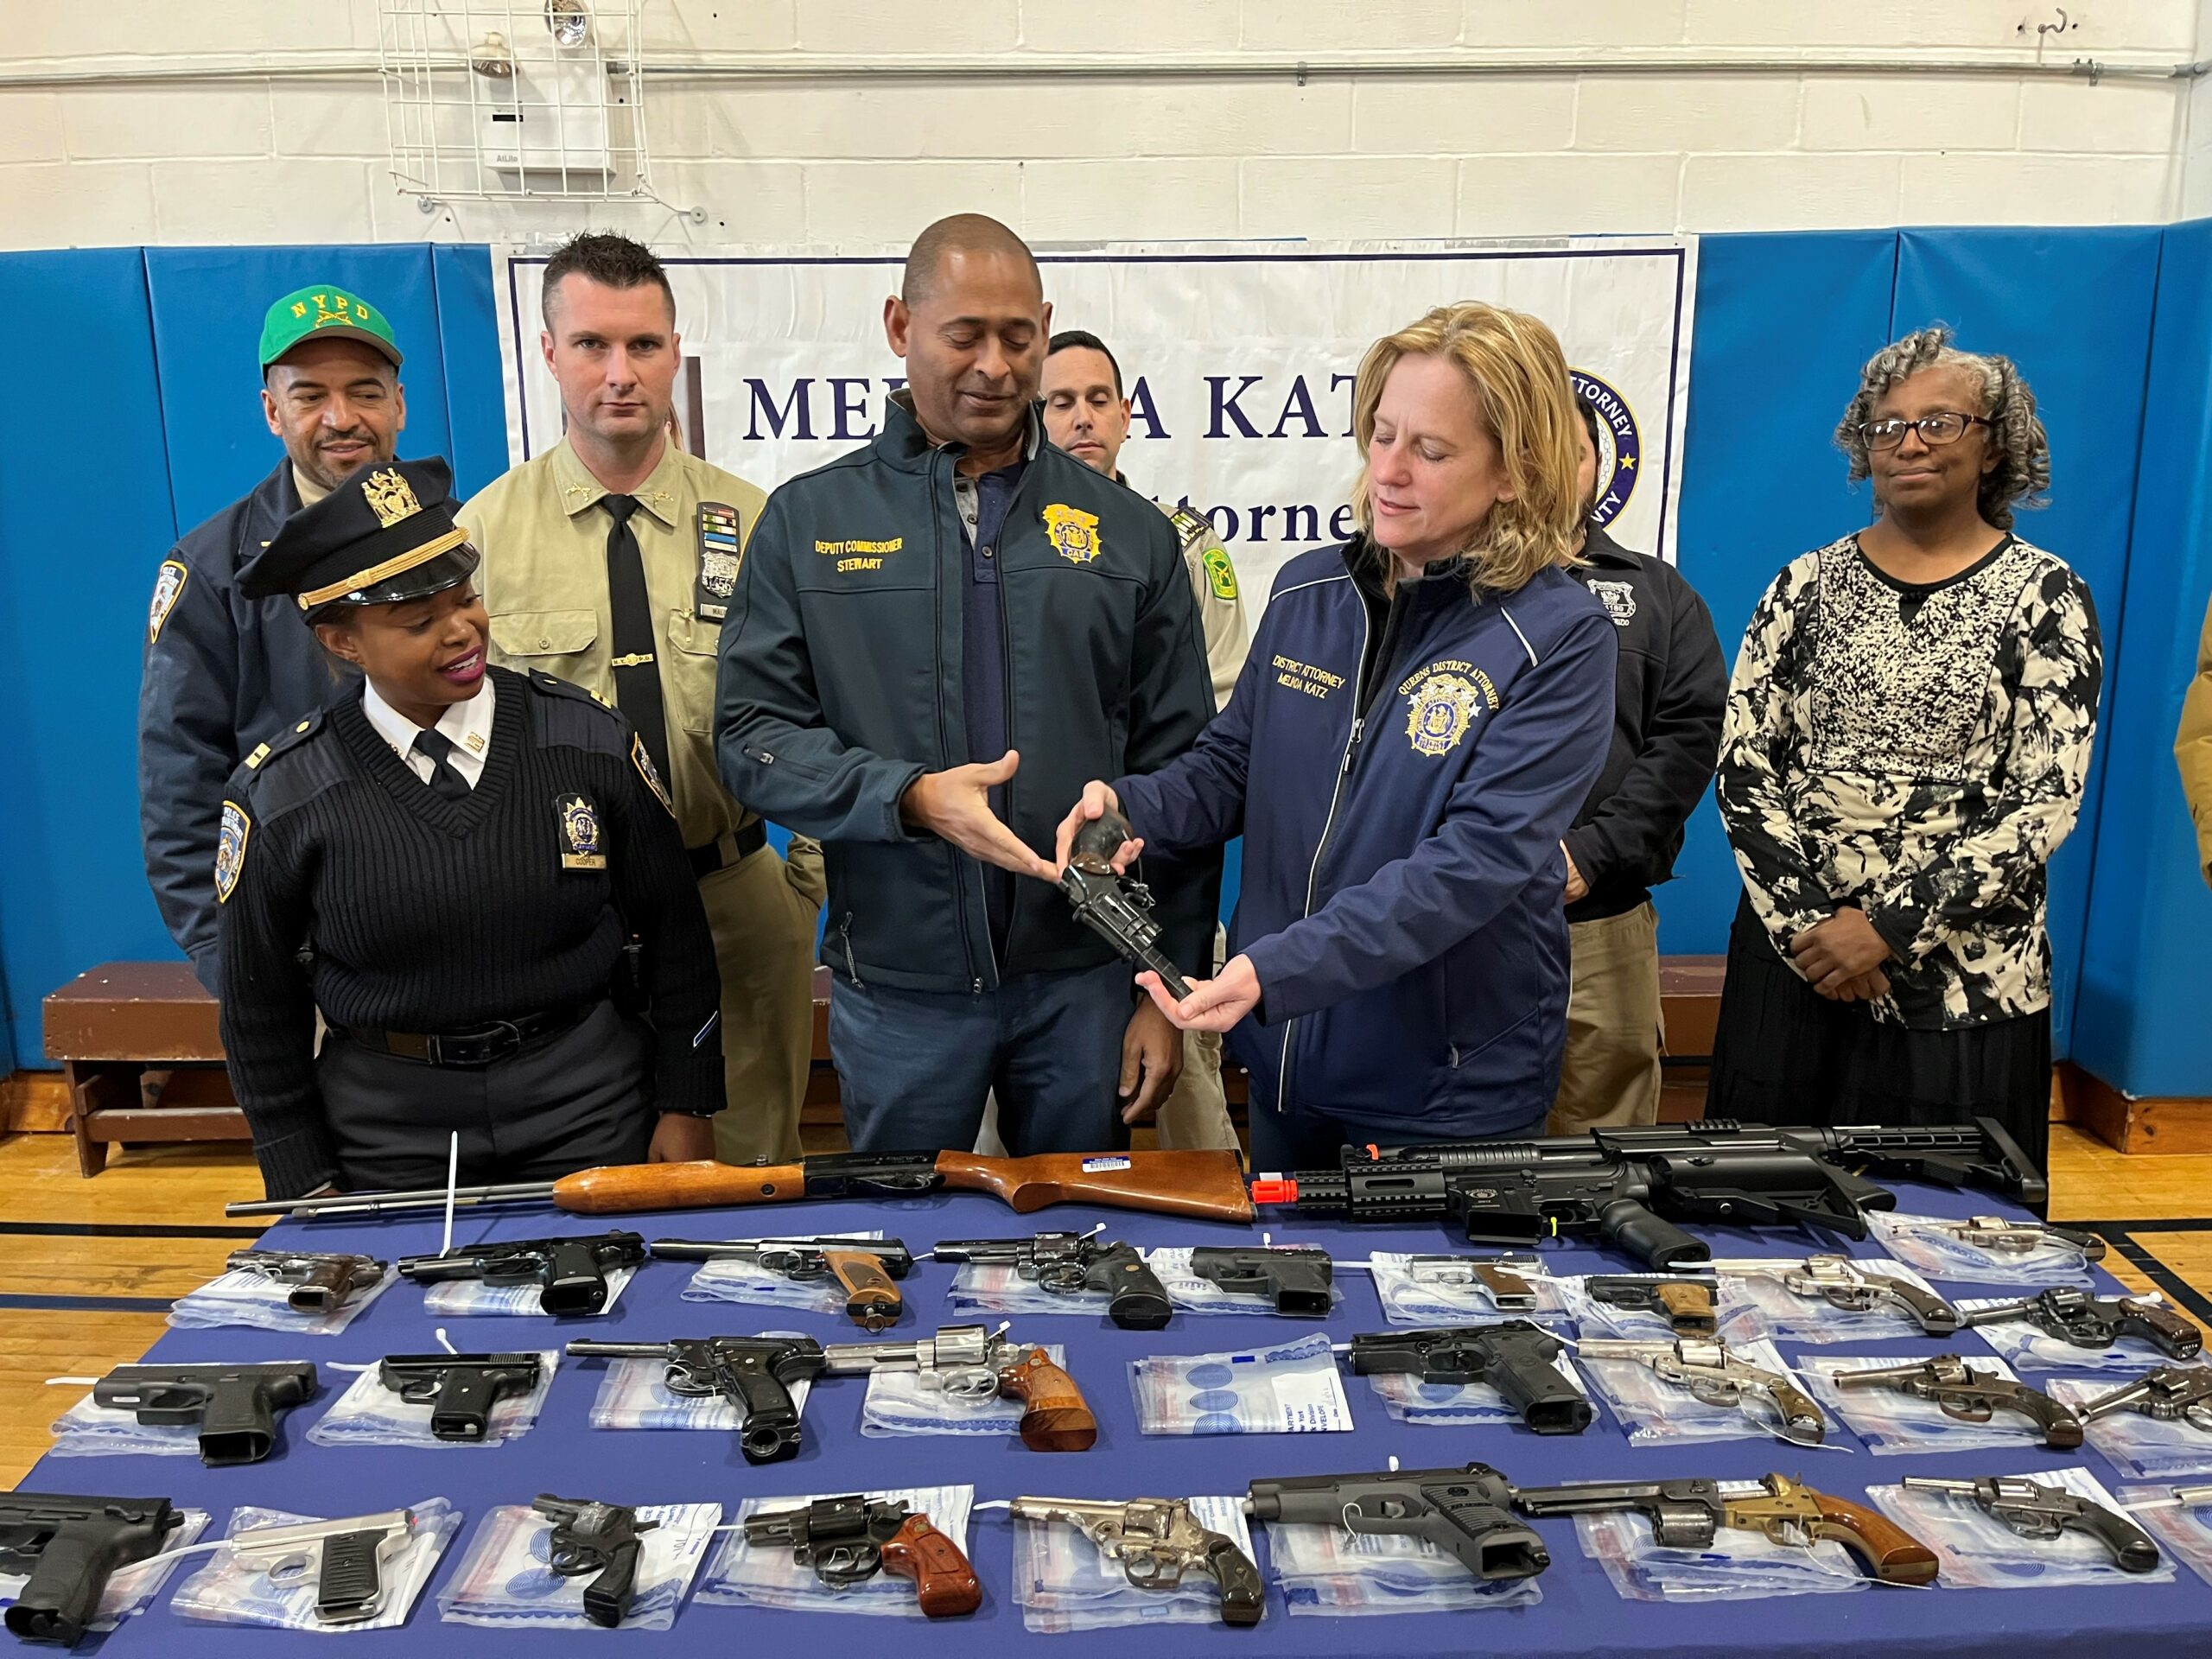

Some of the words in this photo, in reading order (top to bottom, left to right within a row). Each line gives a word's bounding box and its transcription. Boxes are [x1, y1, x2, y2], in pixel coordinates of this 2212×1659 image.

[290, 295, 368, 319] NYPD
[1203, 373, 1359, 438] KAT
[1570, 375, 1633, 436] TORNEY
[815, 539, 845, 555] DEPUTY
[845, 537, 902, 554] COMMISSIONER
[836, 557, 883, 573] STEWART
[1300, 664, 1346, 690] ATTORNEY
[1398, 665, 1431, 696] QUEENS
[1432, 659, 1472, 675] DISTRICT
[1469, 667, 1500, 710] ATTORNEY
[1303, 680, 1329, 700] KATZ
